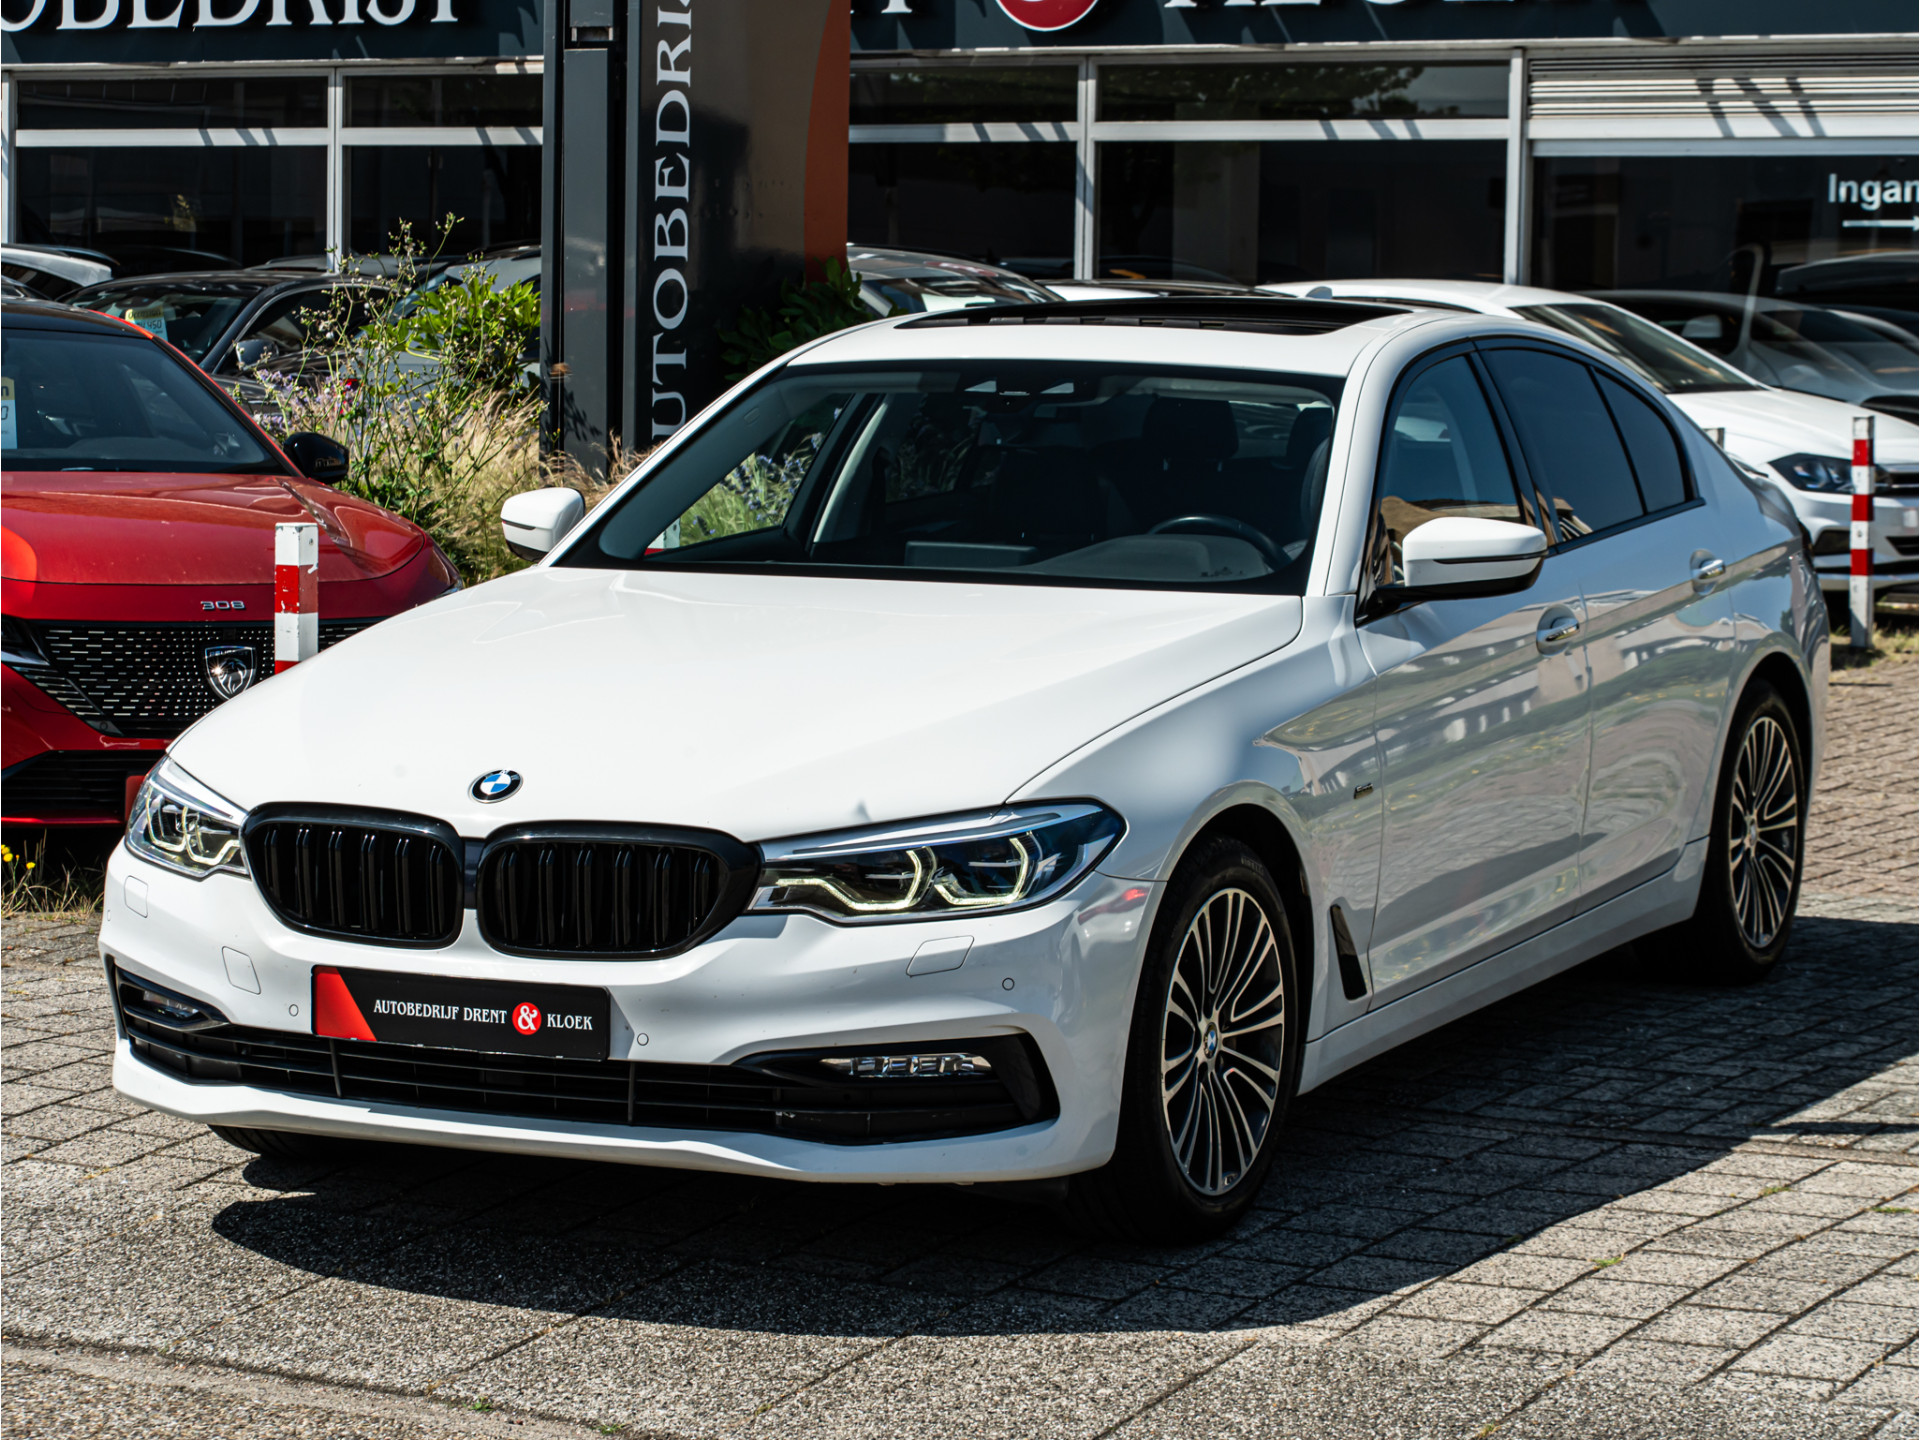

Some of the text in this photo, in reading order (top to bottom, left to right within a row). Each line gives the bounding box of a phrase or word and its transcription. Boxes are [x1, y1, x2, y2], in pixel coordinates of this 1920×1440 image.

[652, 0, 691, 441] UTOBEDRI
[200, 601, 245, 610] 308
[374, 999, 593, 1031] AUTOBEDRIJF DRENT & KLOEK
